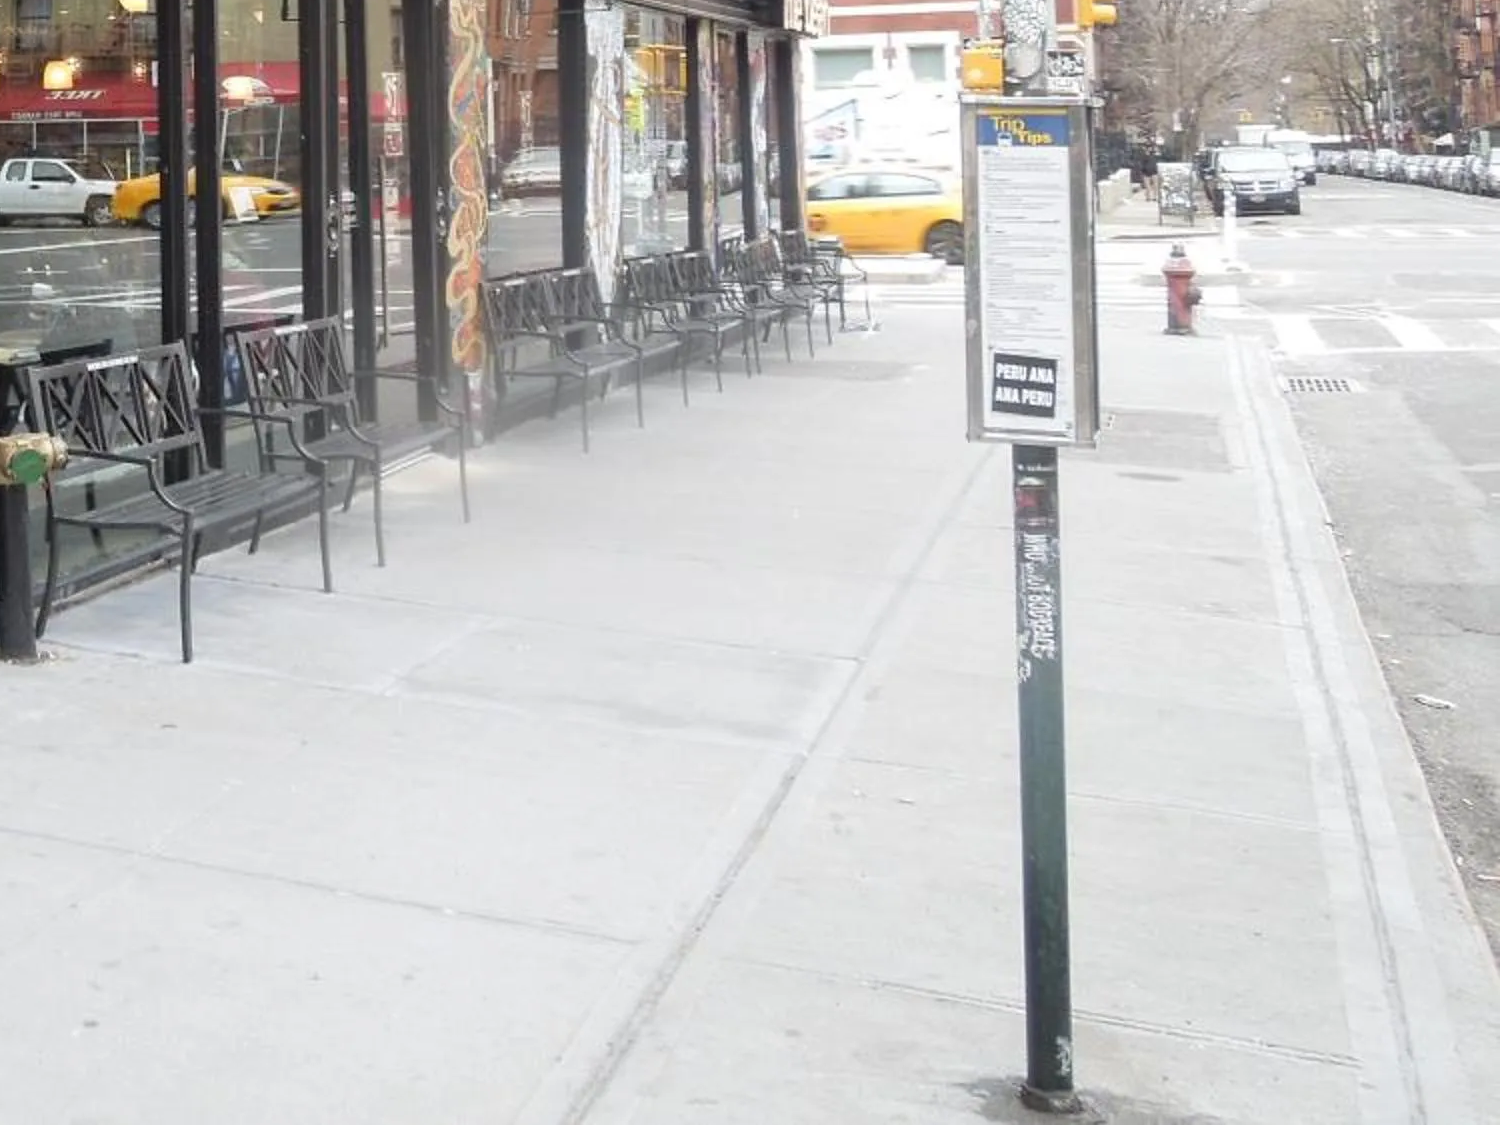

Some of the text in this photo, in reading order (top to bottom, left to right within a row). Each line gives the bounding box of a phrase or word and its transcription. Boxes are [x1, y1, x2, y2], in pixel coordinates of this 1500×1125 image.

[989, 115, 1025, 135] Trip
[1018, 130, 1054, 147] Tips
[995, 362, 1055, 384] PERU ANA
[995, 386, 1053, 408] ANA PERU
